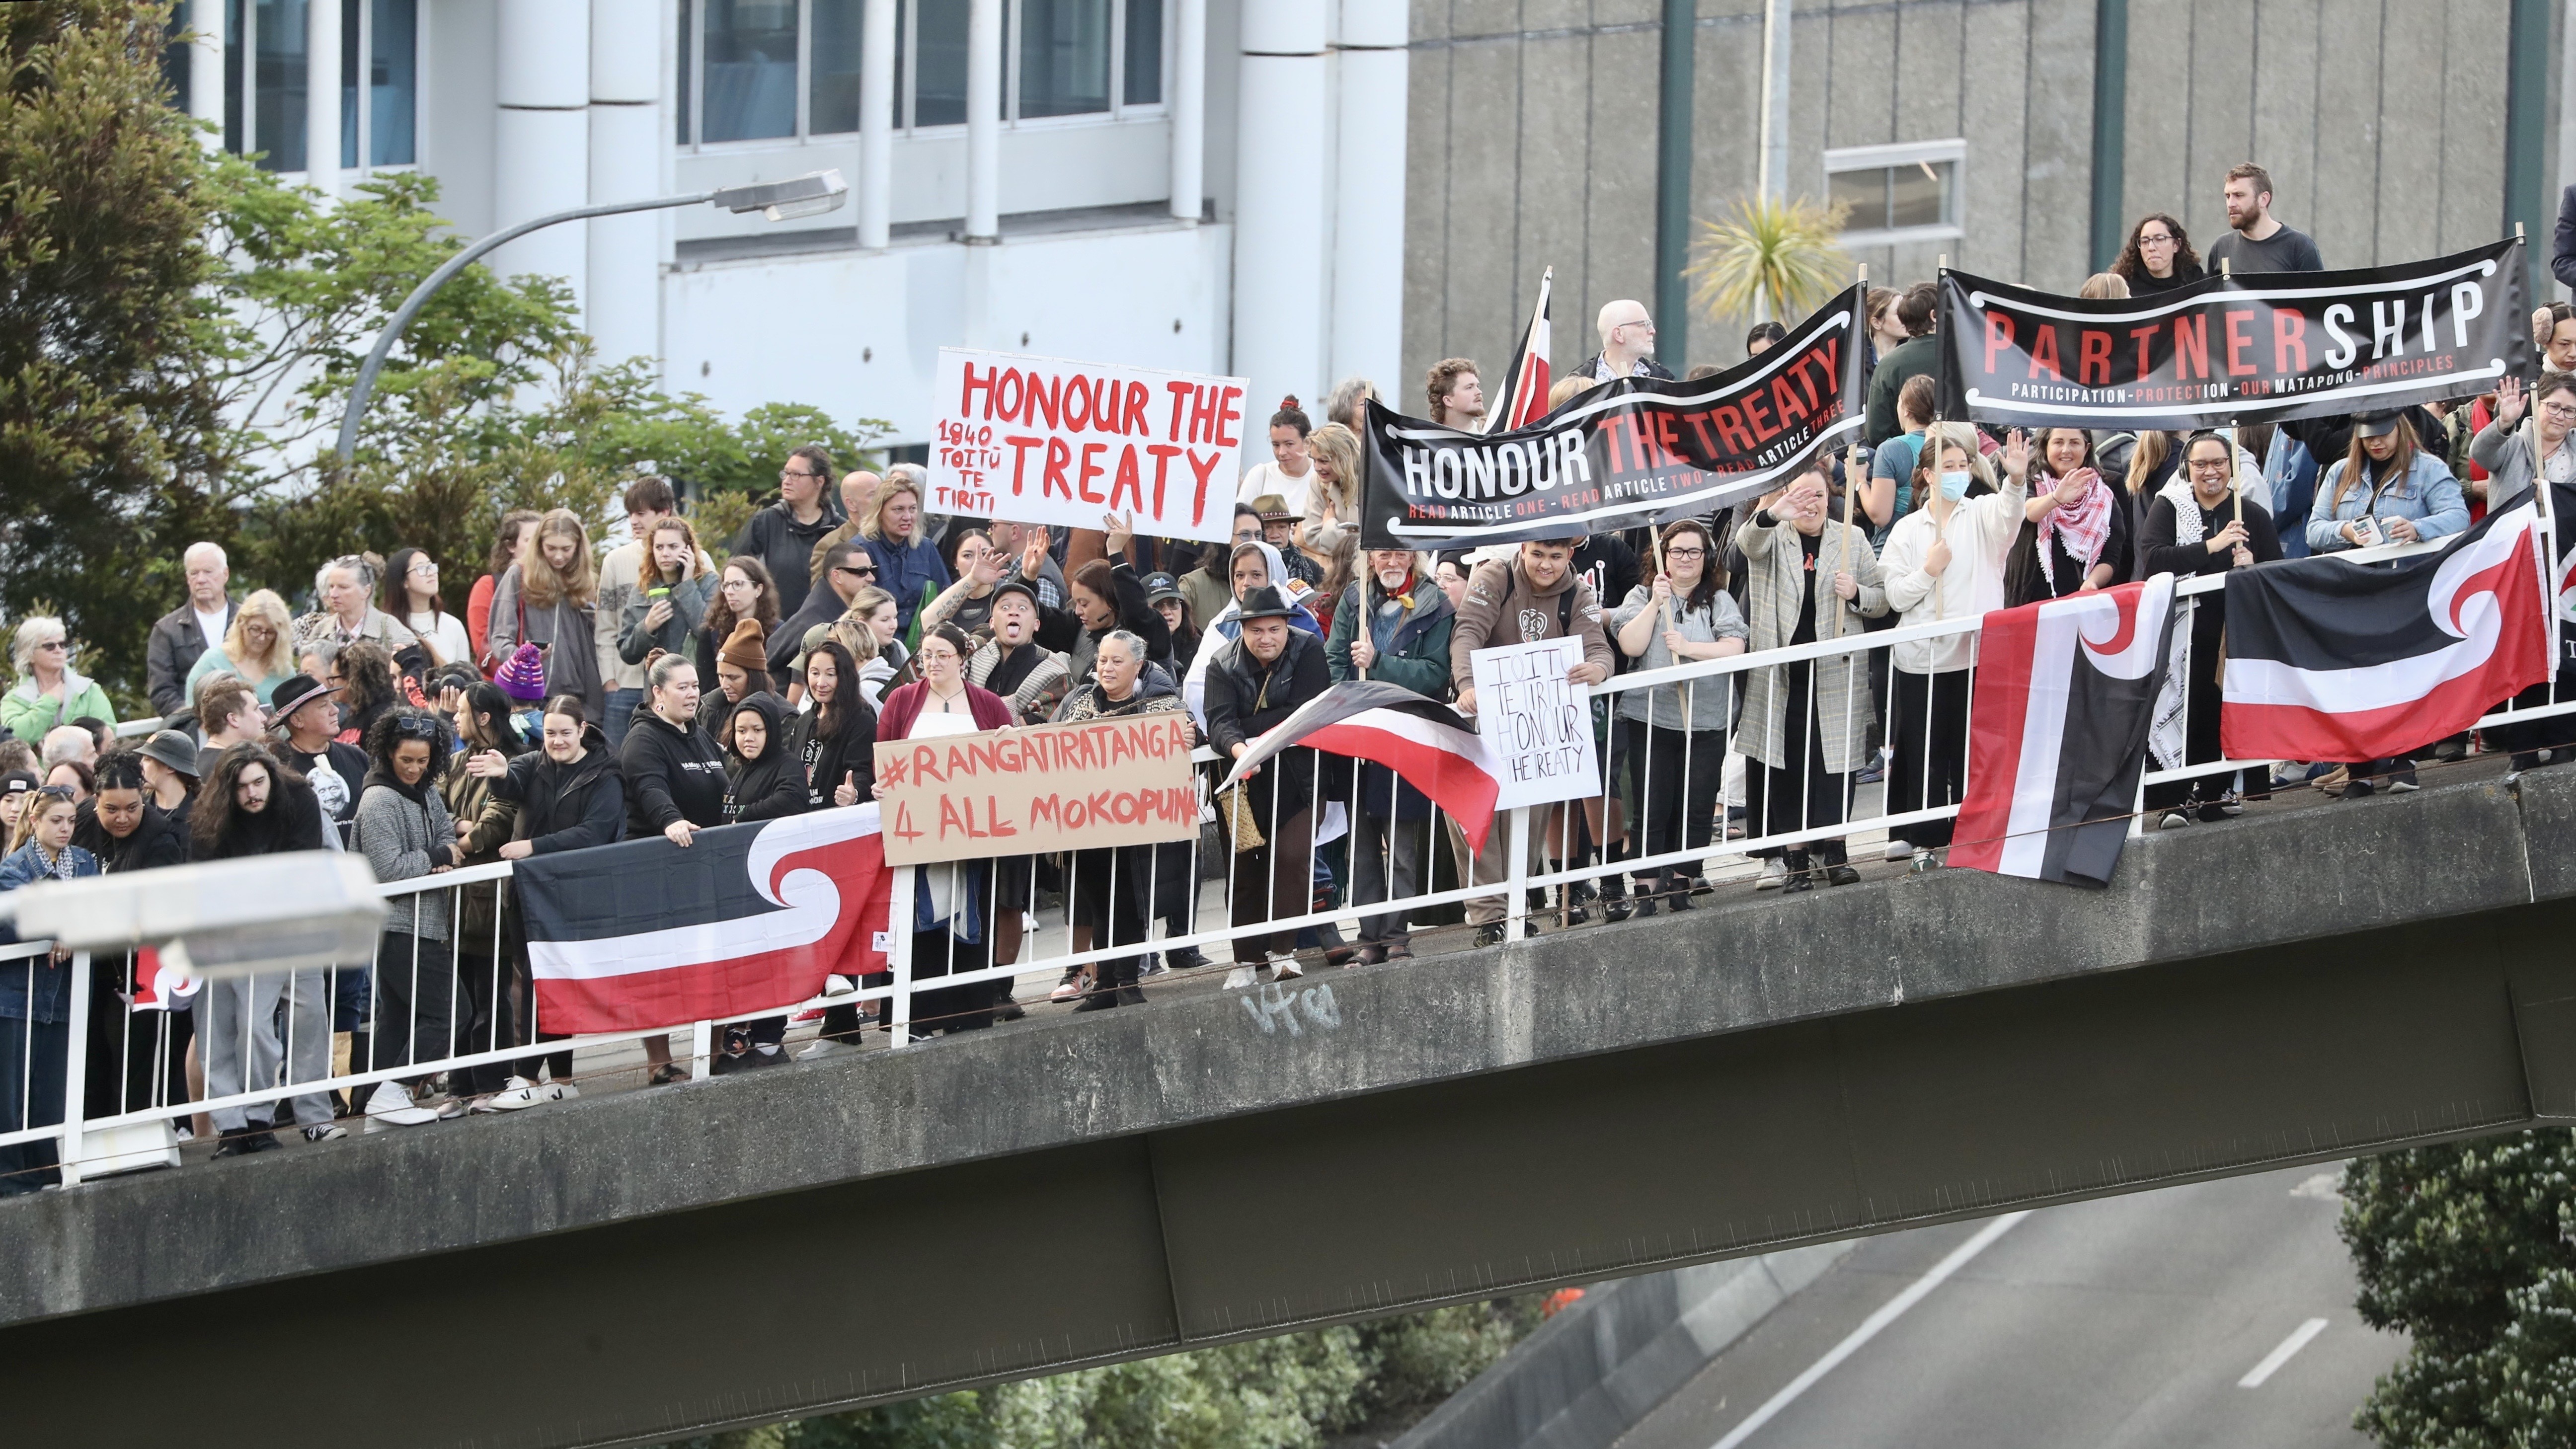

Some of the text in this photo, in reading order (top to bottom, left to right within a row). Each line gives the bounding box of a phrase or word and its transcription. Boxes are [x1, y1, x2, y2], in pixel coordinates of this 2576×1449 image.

[1985, 281, 2483, 384] PARTNERSHIP
[937, 418, 993, 447] 1840
[962, 362, 1242, 448] HONOUR THE
[1403, 338, 1838, 499] HONOUR THE TREATY
[939, 446, 1001, 469] TOITŪ
[959, 470, 984, 488] TE
[1005, 436, 1221, 527] TREATY
[1409, 505, 1446, 519] READ
[1451, 504, 1512, 520] ARTICLE
[1517, 499, 1546, 516] ONE
[1561, 489, 1600, 509] READ
[1605, 477, 1667, 500] ARTICLE
[1670, 471, 1703, 489] TWO
[1717, 459, 1755, 478] READ
[1757, 426, 1810, 467] ARTICLE
[1810, 399, 1846, 433] THREE
[936, 486, 994, 516] TIRITI
[1489, 682, 1519, 715] TE
[878, 719, 1189, 790] #RANGATIRATANGA
[1495, 704, 1583, 754] HONOUR
[1500, 745, 1583, 783] THE TREATY
[893, 785, 1198, 845] 4 ALL MOKOPUNA
